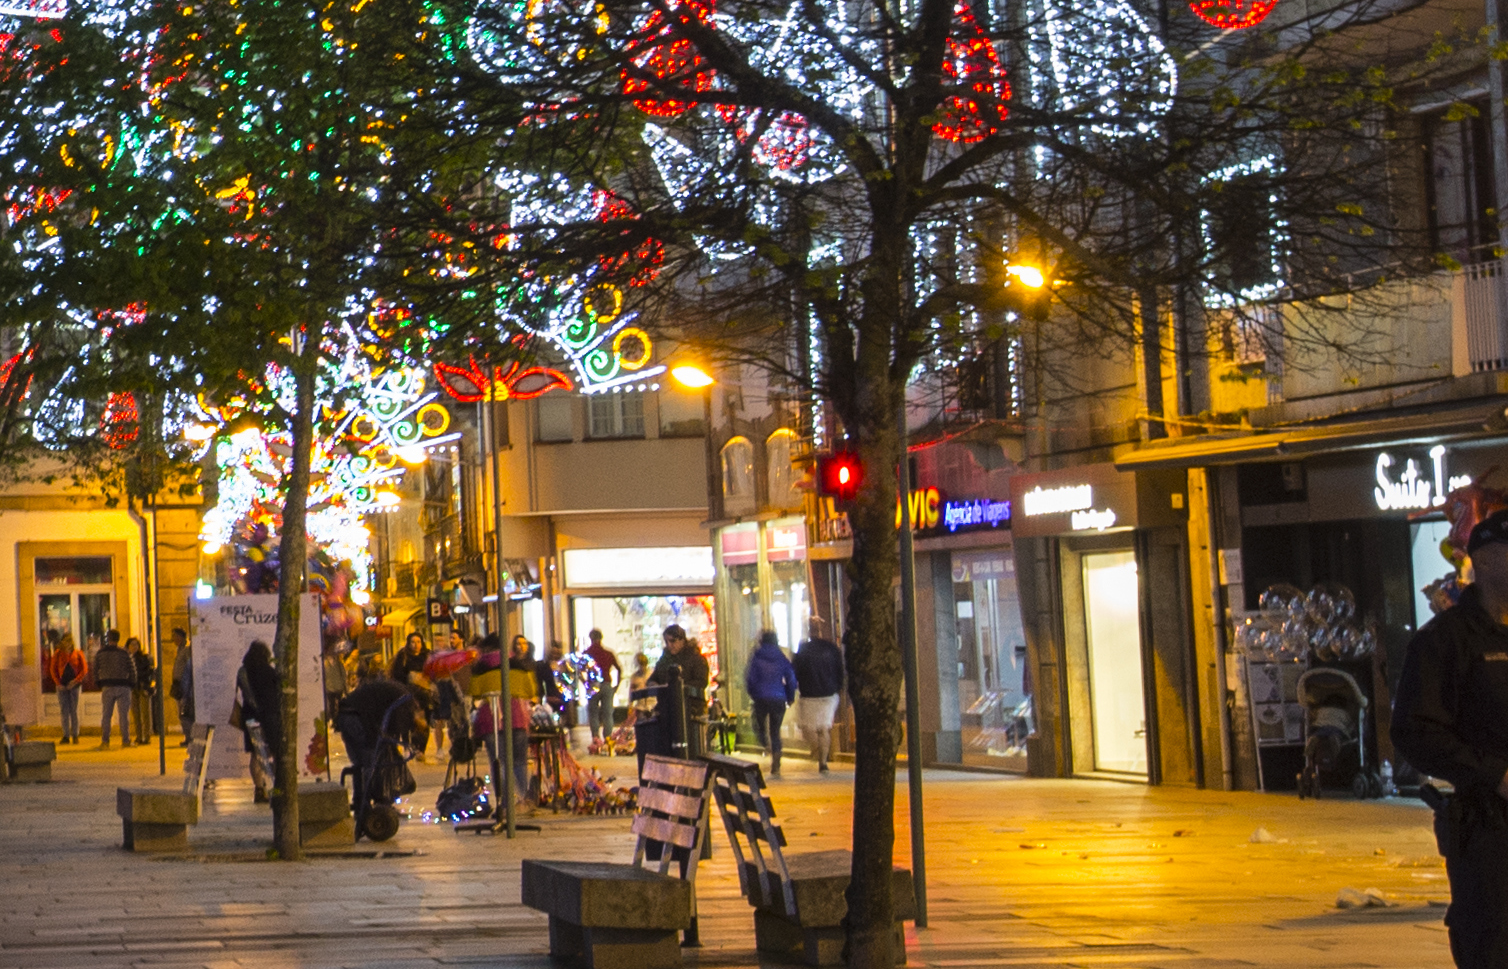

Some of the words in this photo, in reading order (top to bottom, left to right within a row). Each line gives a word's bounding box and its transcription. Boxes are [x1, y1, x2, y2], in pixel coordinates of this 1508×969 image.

[895, 486, 940, 529] VIC
[972, 499, 981, 524] de
[220, 605, 253, 616] FESTA
[233, 610, 279, 625] Cruze
